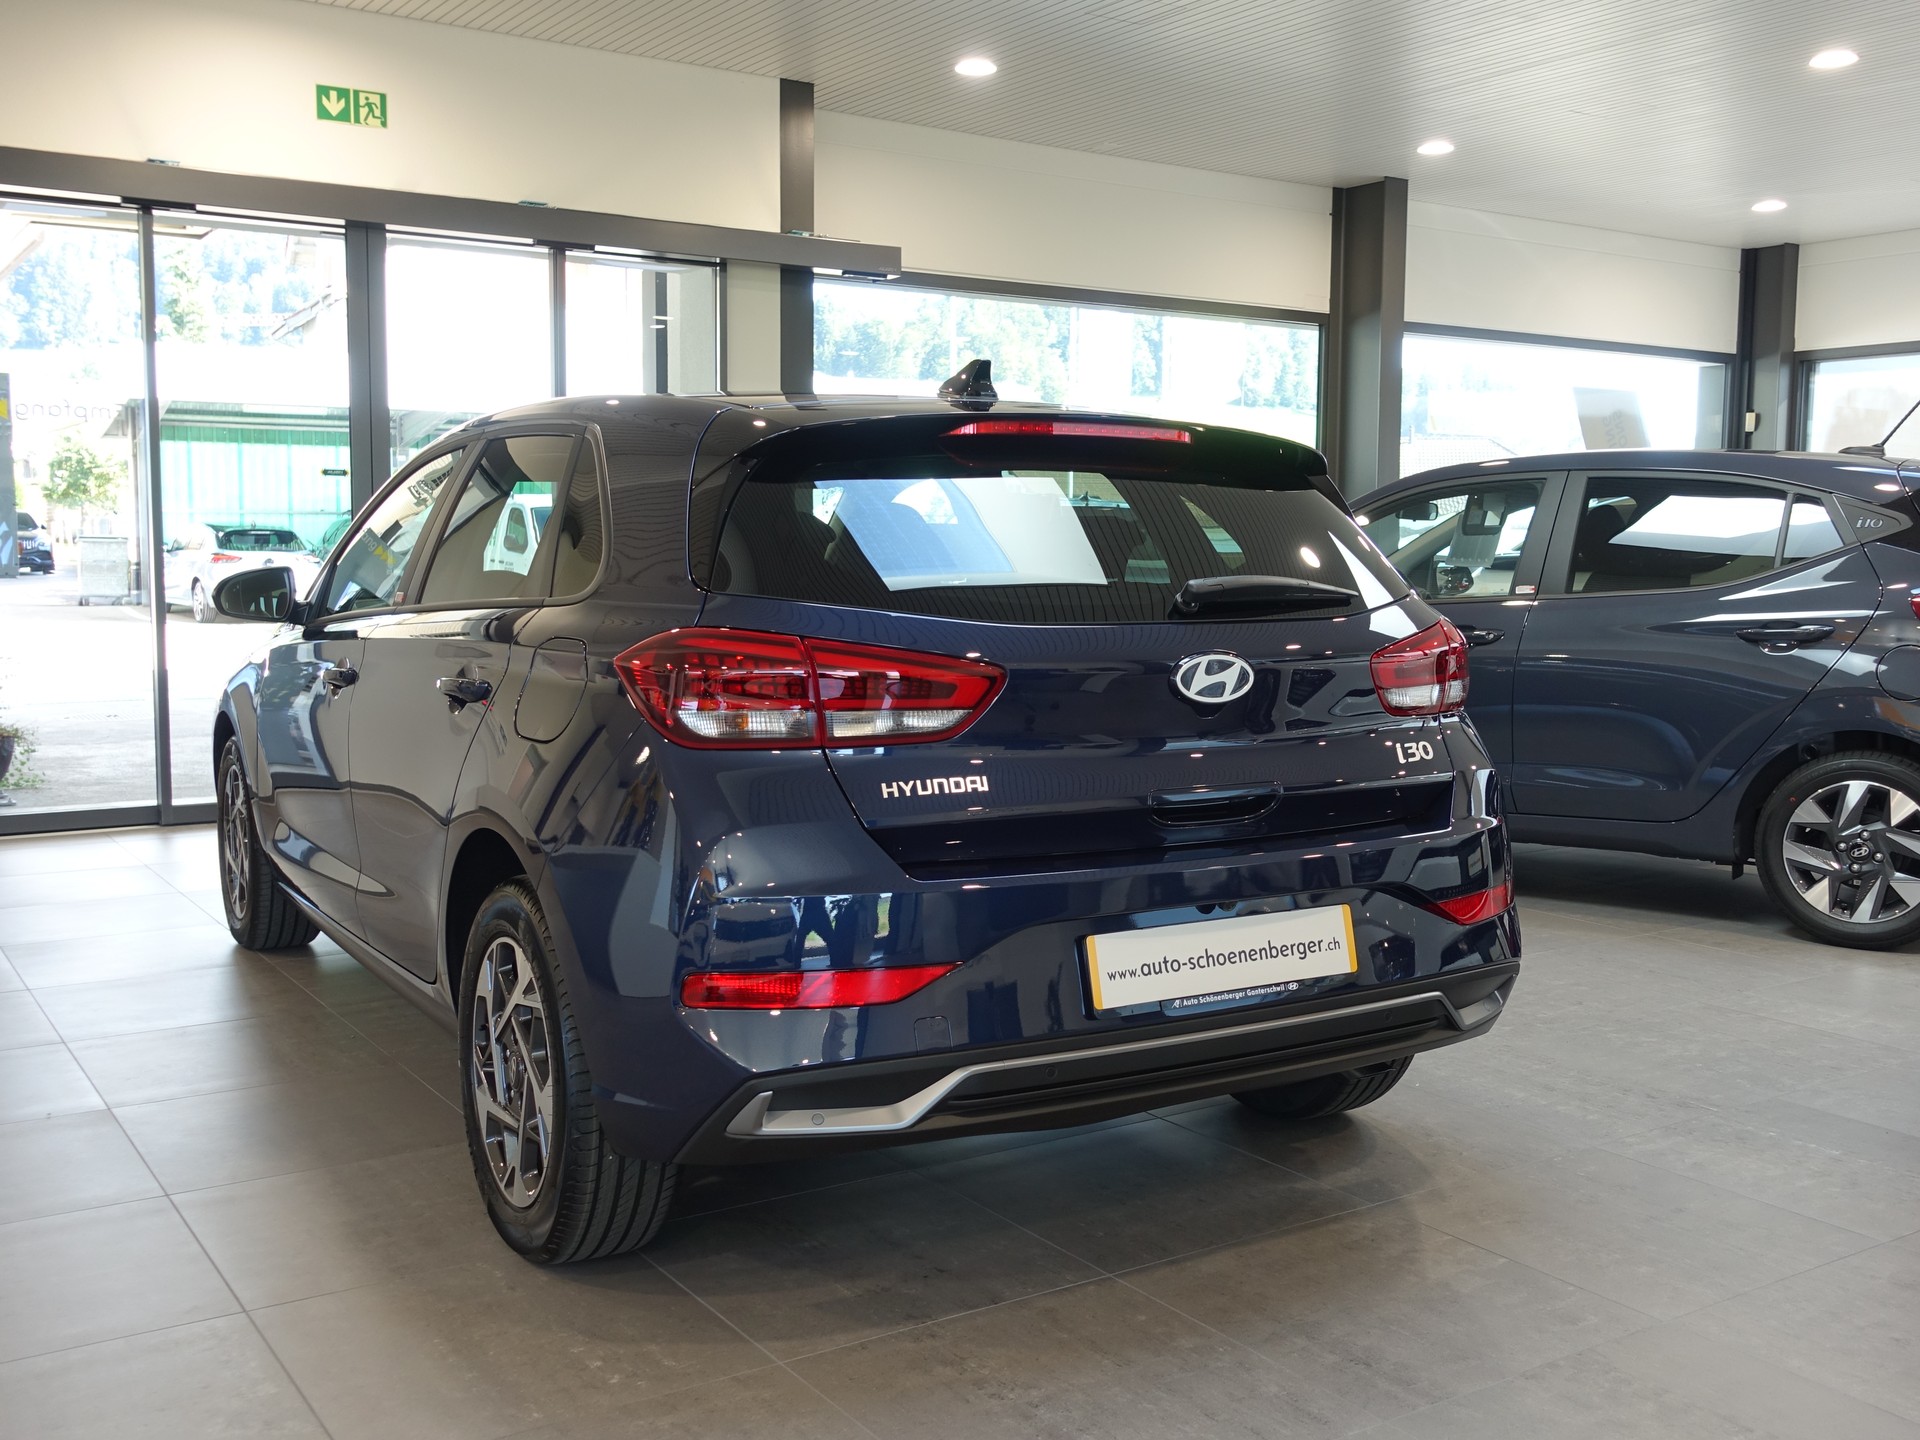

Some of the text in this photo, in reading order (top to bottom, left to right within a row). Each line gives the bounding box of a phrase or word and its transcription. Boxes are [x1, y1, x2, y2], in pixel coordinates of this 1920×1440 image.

[1856, 516, 1883, 528] i10
[1395, 741, 1434, 764] i30
[881, 775, 989, 799] HYUNDAI
[1107, 936, 1341, 981] www.auto-schoenenberger.ch
[1182, 998, 1199, 1007] Auto
[1199, 989, 1246, 1004] Schönenberger
